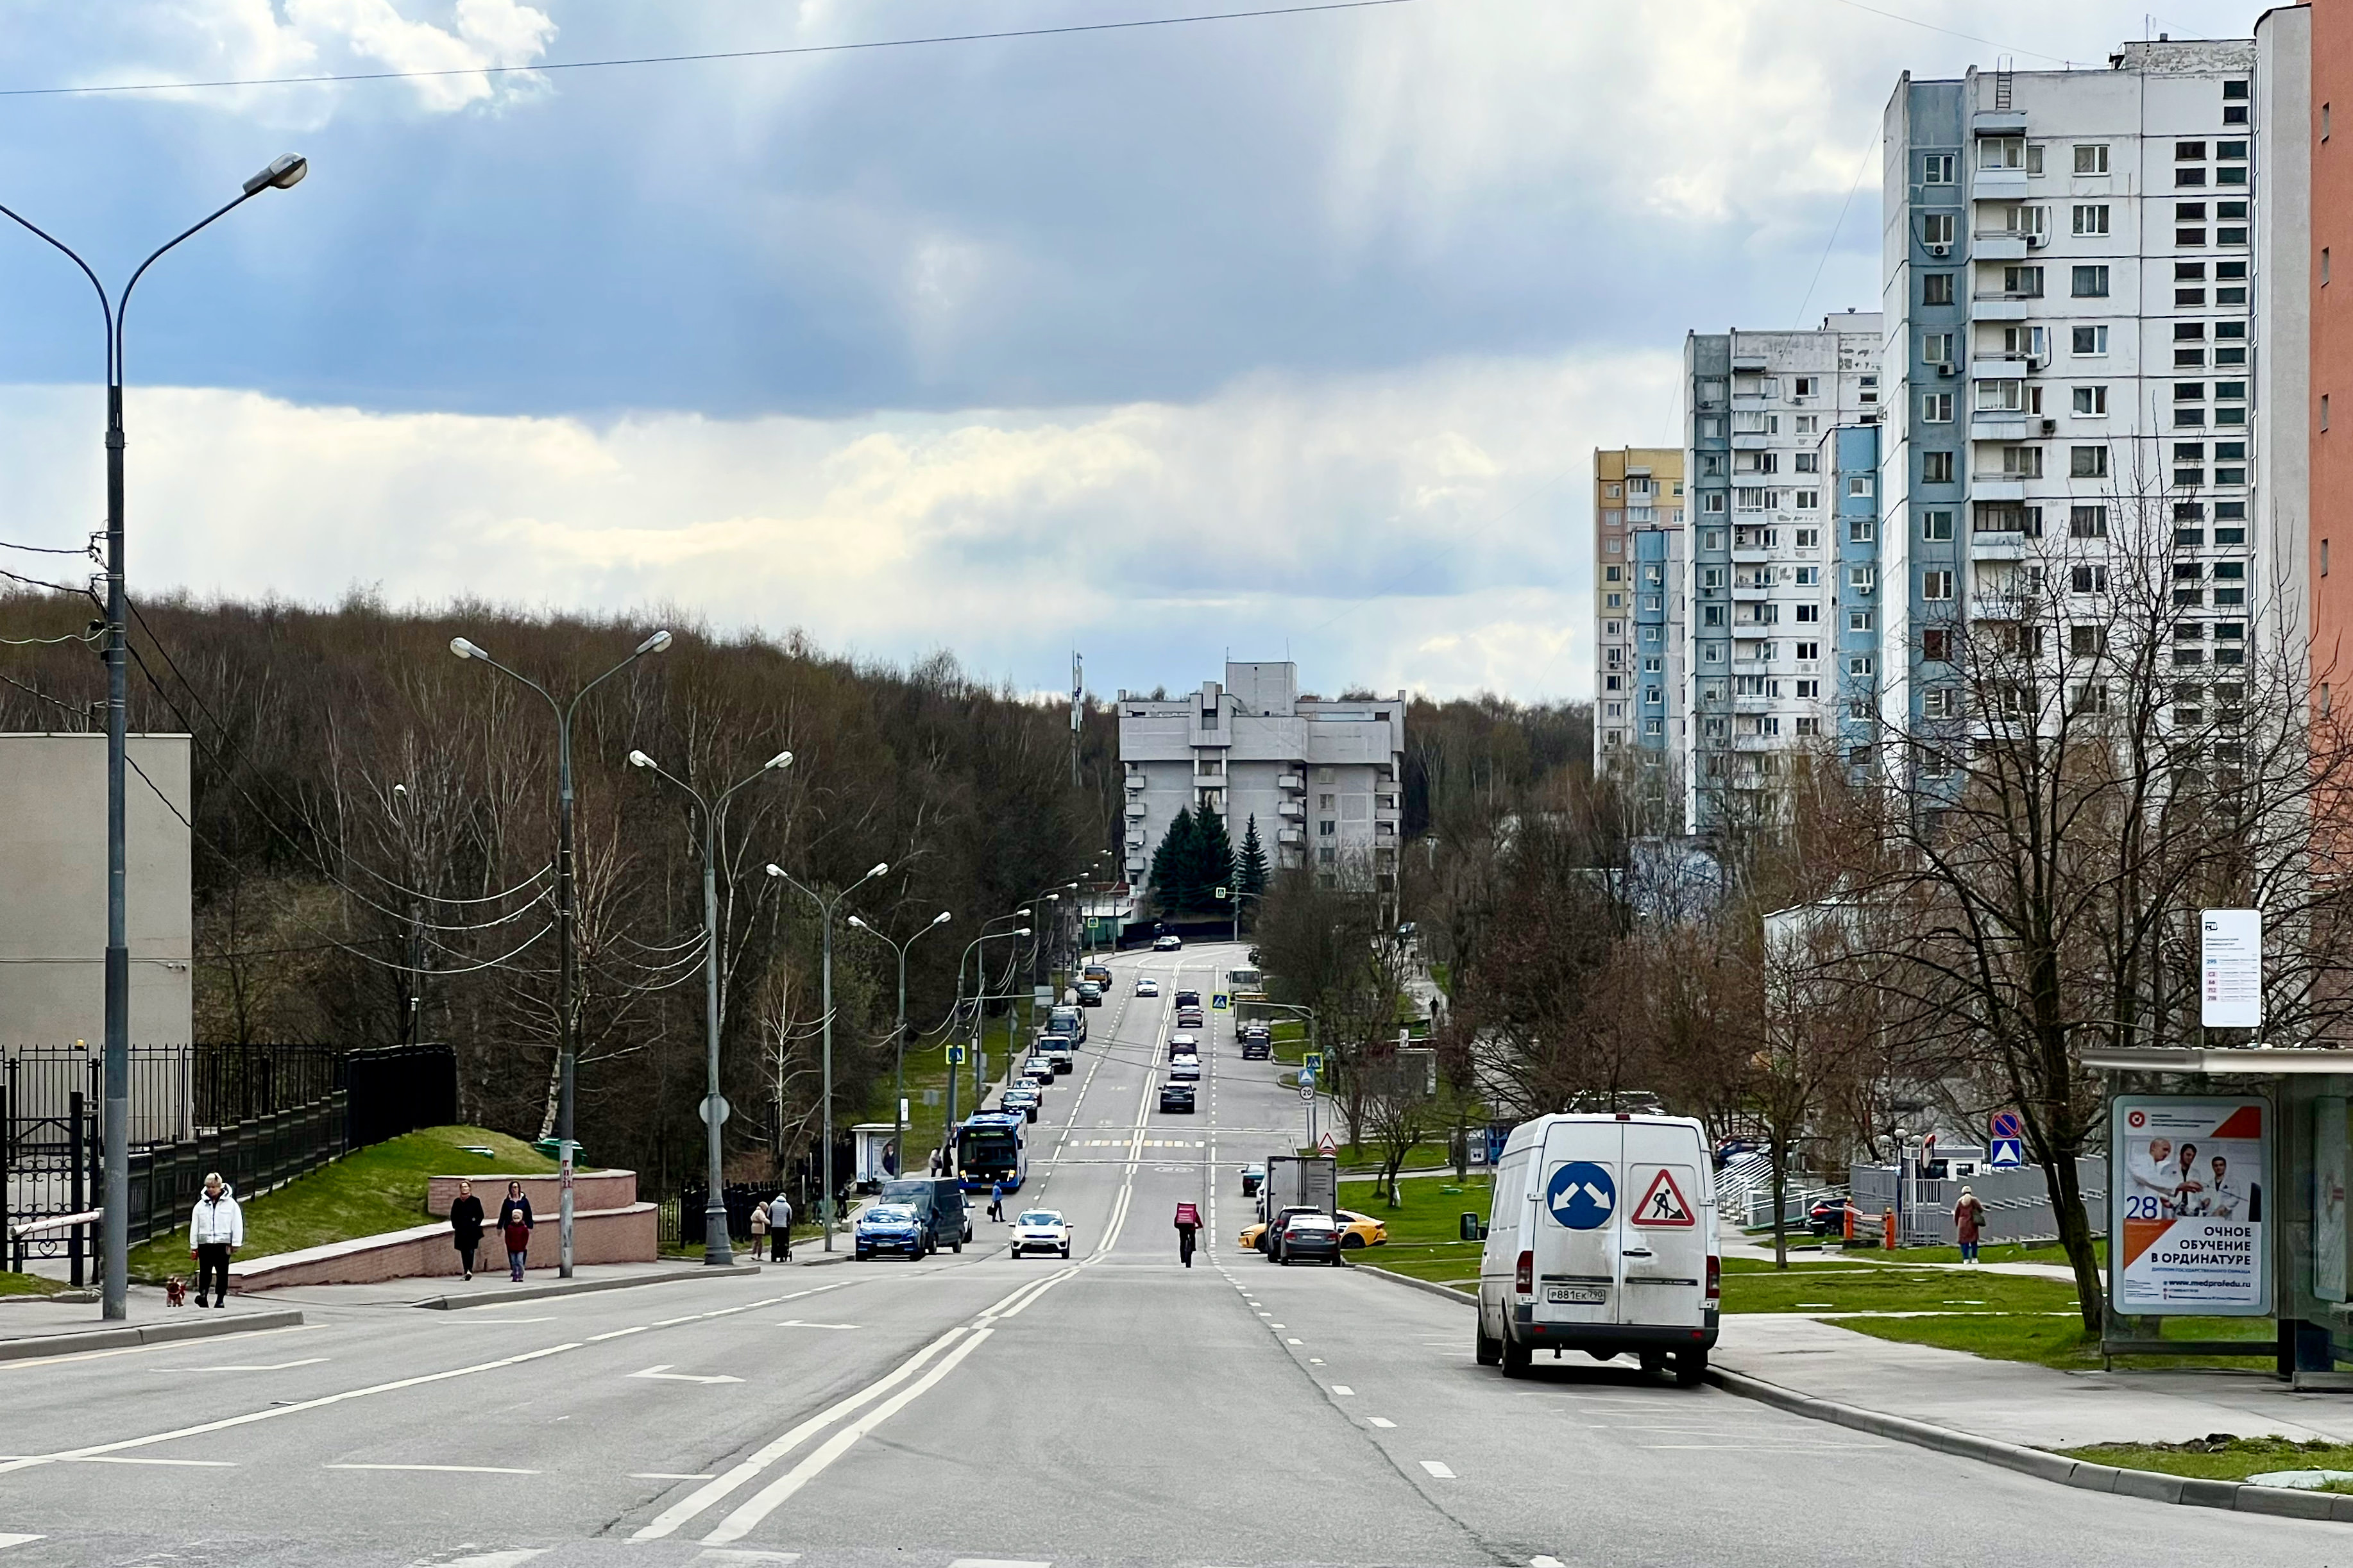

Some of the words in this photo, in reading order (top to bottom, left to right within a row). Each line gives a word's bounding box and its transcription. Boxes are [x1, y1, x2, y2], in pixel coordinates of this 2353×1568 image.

[2126, 1195, 2157, 1219] 28
[2204, 1226, 2252, 1237] ОЧНОЕ
[2180, 1239, 2251, 1251] ОБУЧЕНИЕ
[2151, 1252, 2158, 1263] В
[2162, 1253, 2251, 1265] ОРДИНАТУРЕ
[2169, 1279, 2251, 1288] www.medprofedu.ru
